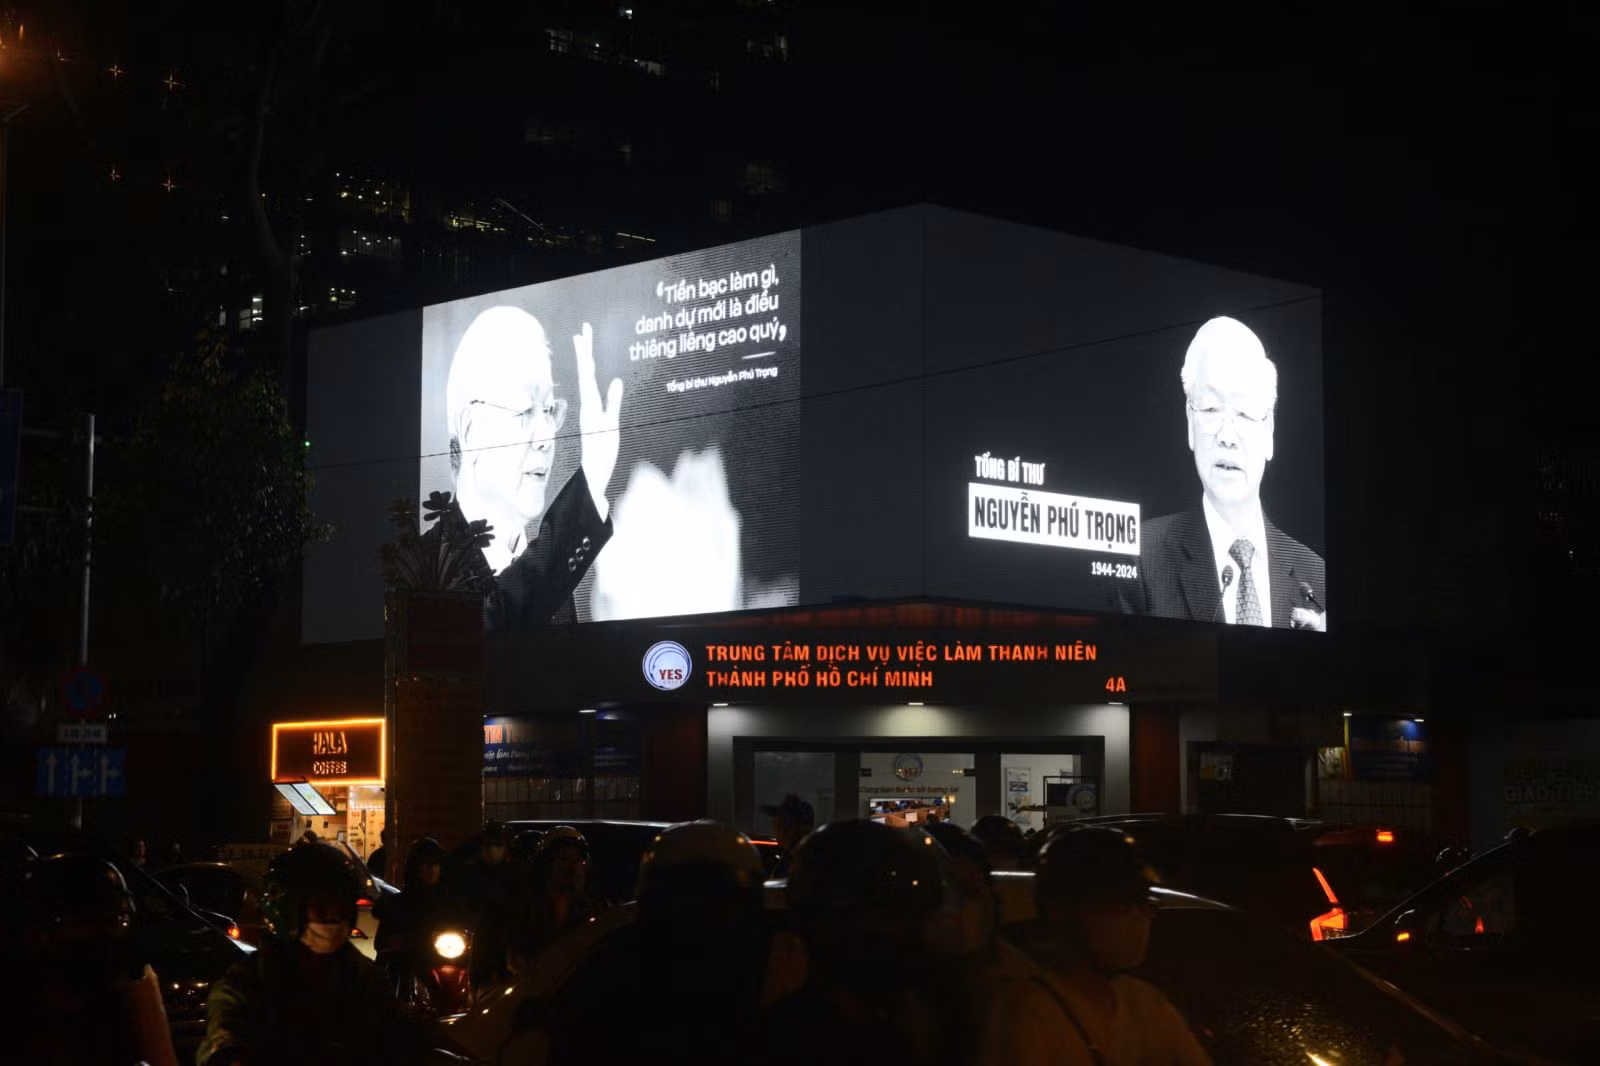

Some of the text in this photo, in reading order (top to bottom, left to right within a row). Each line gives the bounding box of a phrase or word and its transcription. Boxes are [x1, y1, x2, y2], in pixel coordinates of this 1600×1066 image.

[699, 278, 727, 299] bạc
[730, 271, 758, 292] làm
[635, 289, 779, 335] danh dự mới là điều
[629, 339, 676, 361] thiêng
[680, 331, 715, 353] liêng
[718, 326, 747, 345] cao
[708, 370, 738, 387] Nguyễn
[739, 368, 754, 380] Phú
[755, 367, 778, 379] Trọng
[975, 451, 1046, 486] TỔNG BÍ THƯ
[974, 491, 1137, 549] NGUYỄN PHÚ TRỌNG
[1091, 561, 1138, 579] 1944-2024
[705, 640, 1097, 668] TRUNG TÂM DỊCH VỤ VIỆC LÀM THANH NIÊN
[659, 668, 683, 681] YES
[706, 663, 933, 687] THÀNH PHỐ HỒ CHÍ MINH
[1105, 677, 1126, 692] 4A
[313, 761, 347, 774] COFFEE
